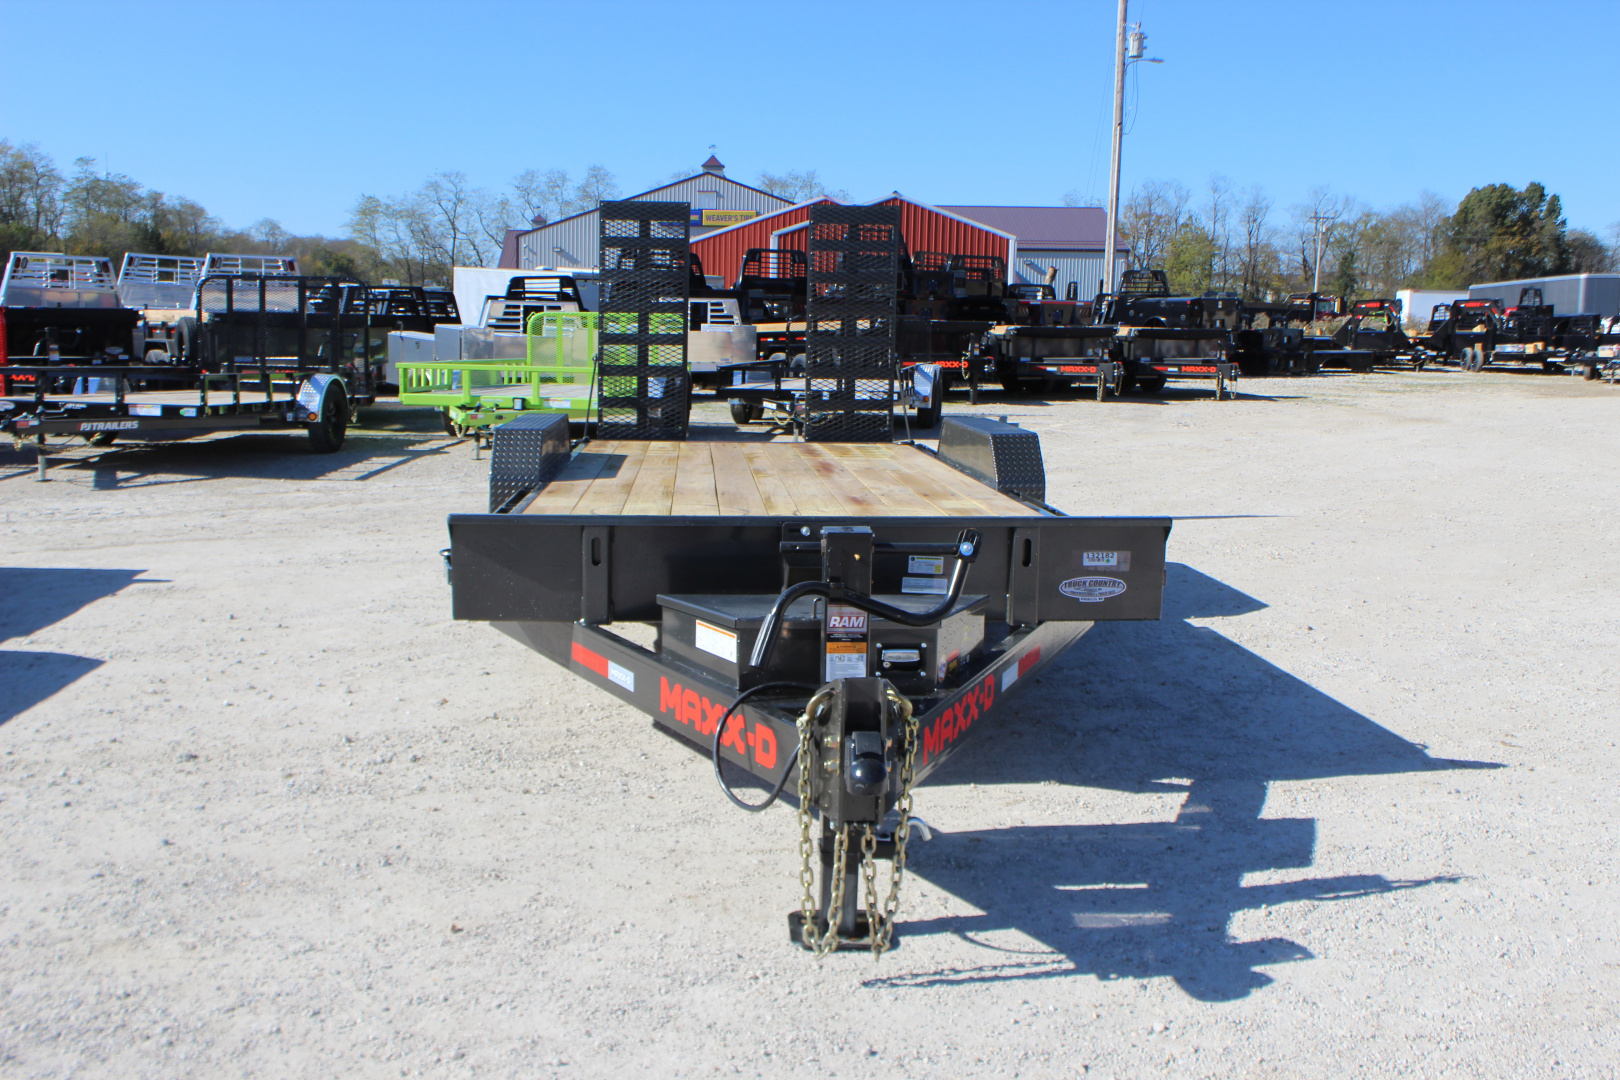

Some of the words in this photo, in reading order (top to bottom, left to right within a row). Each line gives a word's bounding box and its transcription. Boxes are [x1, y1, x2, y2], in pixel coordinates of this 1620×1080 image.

[1060, 365, 1097, 373] MAXX-D
[1181, 365, 1217, 373] MAXX-D
[1064, 580, 1088, 589] TRUCK
[1088, 579, 1121, 588] COUNTRY
[829, 616, 864, 628] RAM
[660, 675, 777, 770] MAXX-D
[923, 673, 995, 766] MAXX-D
